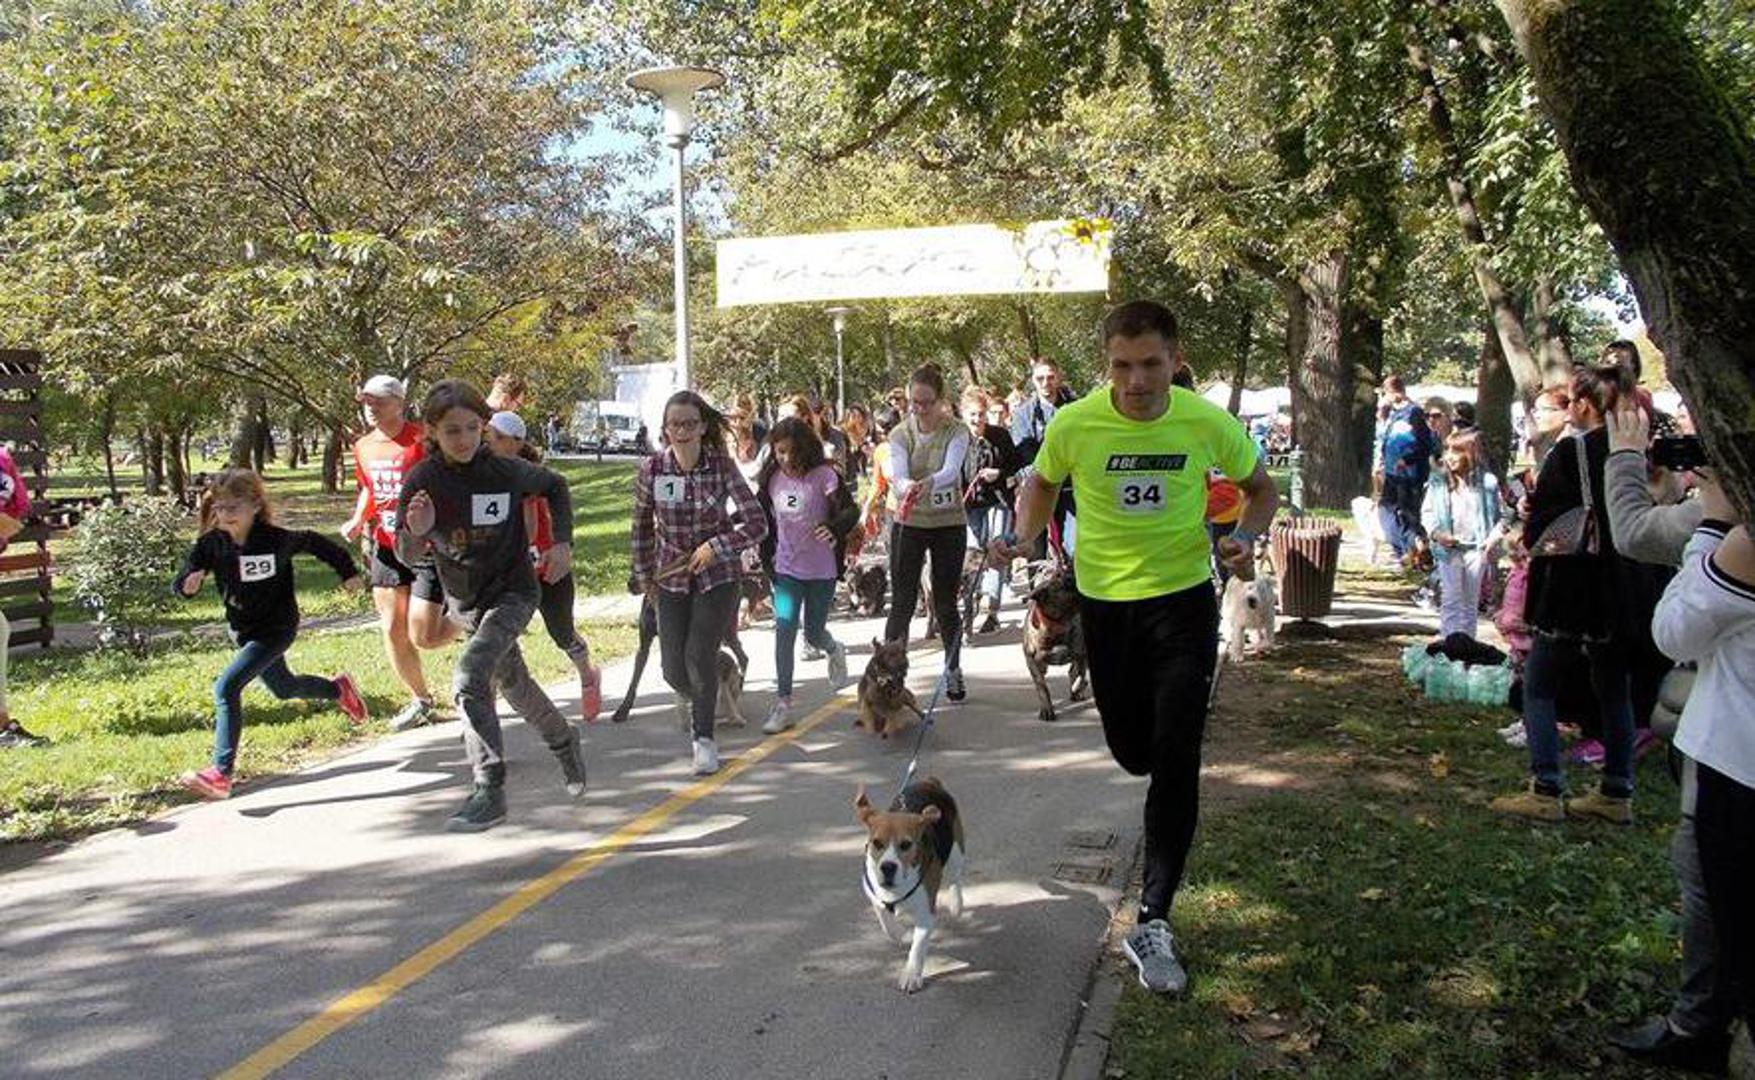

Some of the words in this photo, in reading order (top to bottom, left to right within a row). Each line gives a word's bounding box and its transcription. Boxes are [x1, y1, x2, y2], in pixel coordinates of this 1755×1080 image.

[665, 482, 674, 495] 1
[1124, 484, 1161, 505] 34
[787, 495, 797, 507] 2
[934, 492, 952, 505] 31
[485, 502, 499, 517] 4
[245, 561, 271, 576] 29
